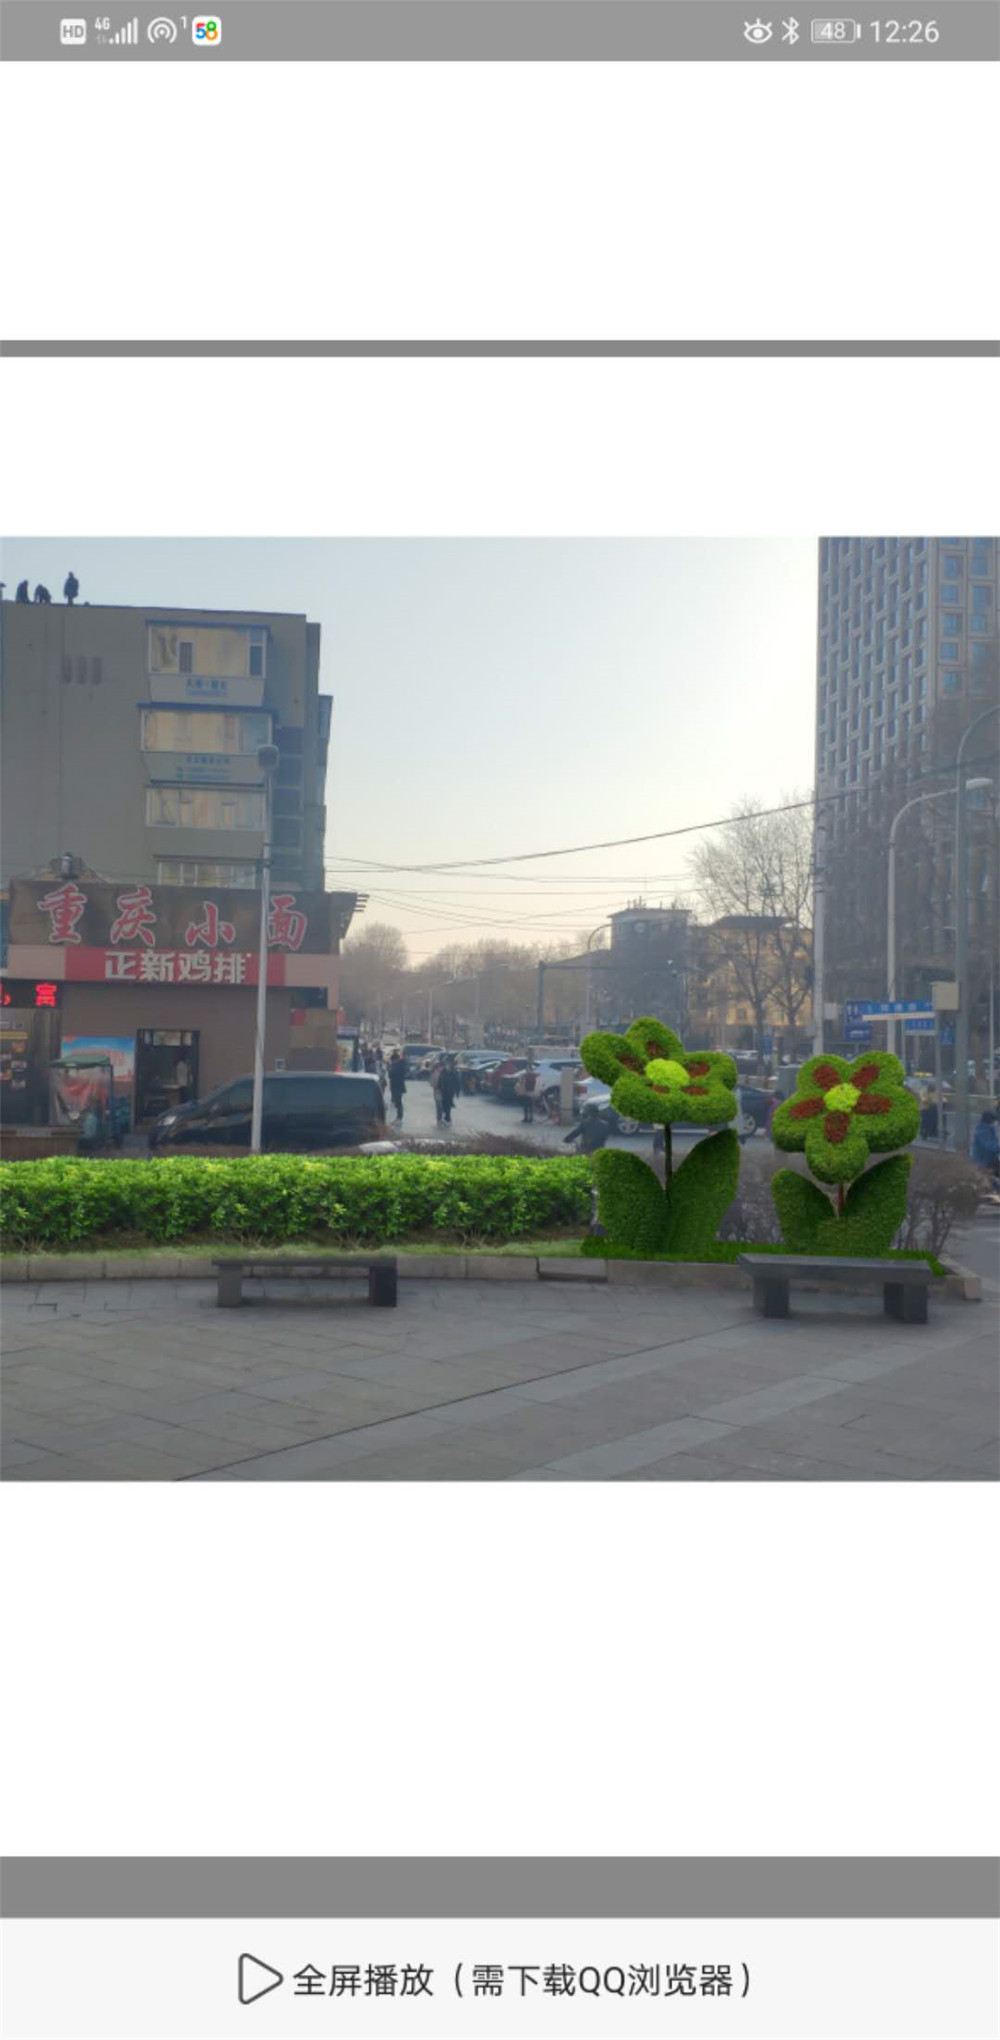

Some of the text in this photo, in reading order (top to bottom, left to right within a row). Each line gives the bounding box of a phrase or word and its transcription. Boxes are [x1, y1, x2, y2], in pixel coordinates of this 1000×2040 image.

[37, 883, 308, 950] 重庆小面
[105, 950, 247, 984] 正新鸡排
